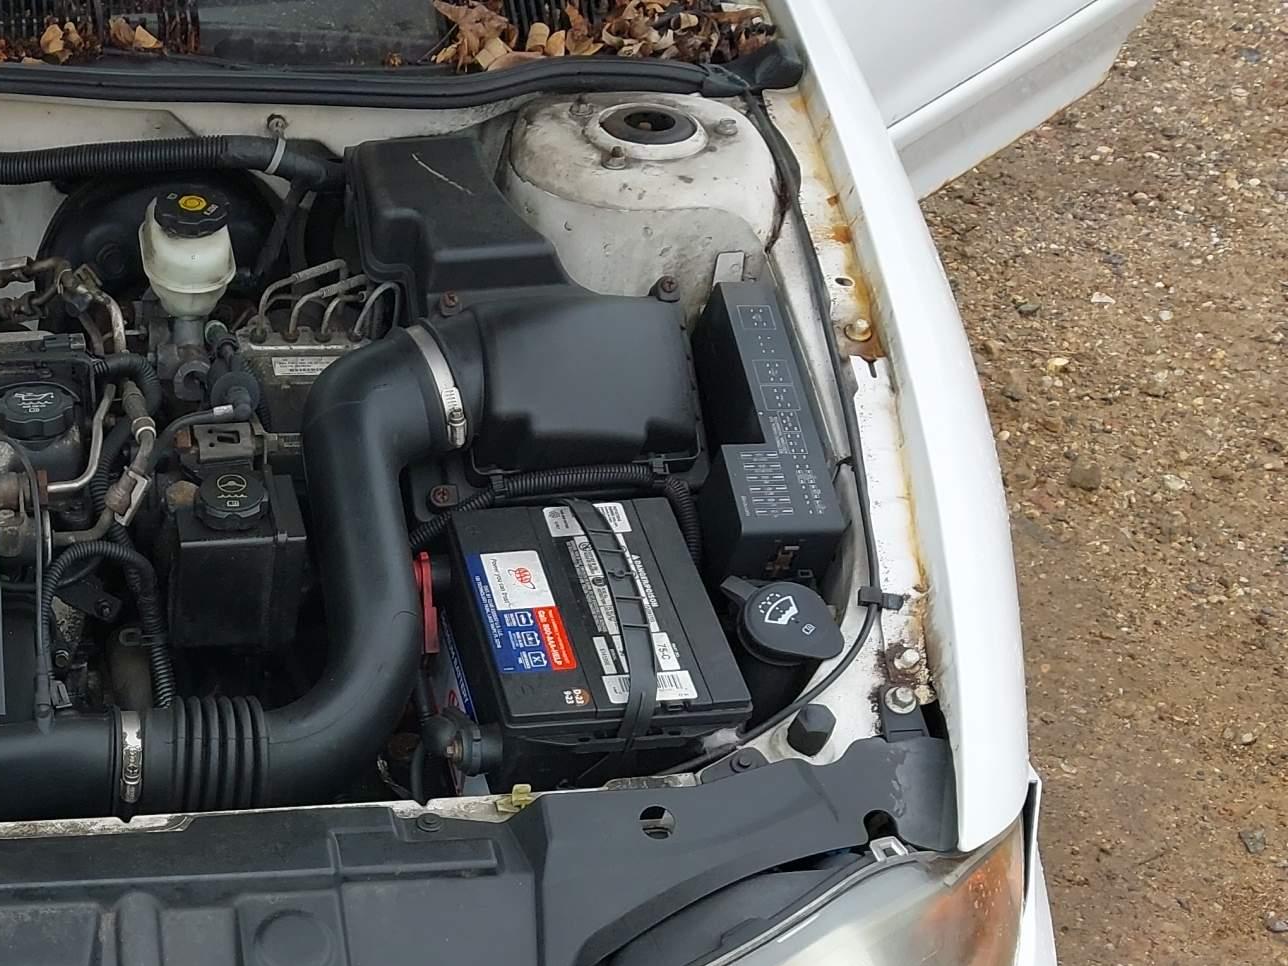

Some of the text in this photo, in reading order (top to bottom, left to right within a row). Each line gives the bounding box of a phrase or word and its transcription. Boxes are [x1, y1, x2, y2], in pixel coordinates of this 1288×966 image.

[490, 559, 501, 573] Power
[493, 574, 503, 582] you
[498, 583, 506, 592] can
[657, 643, 671, 660] 75-C
